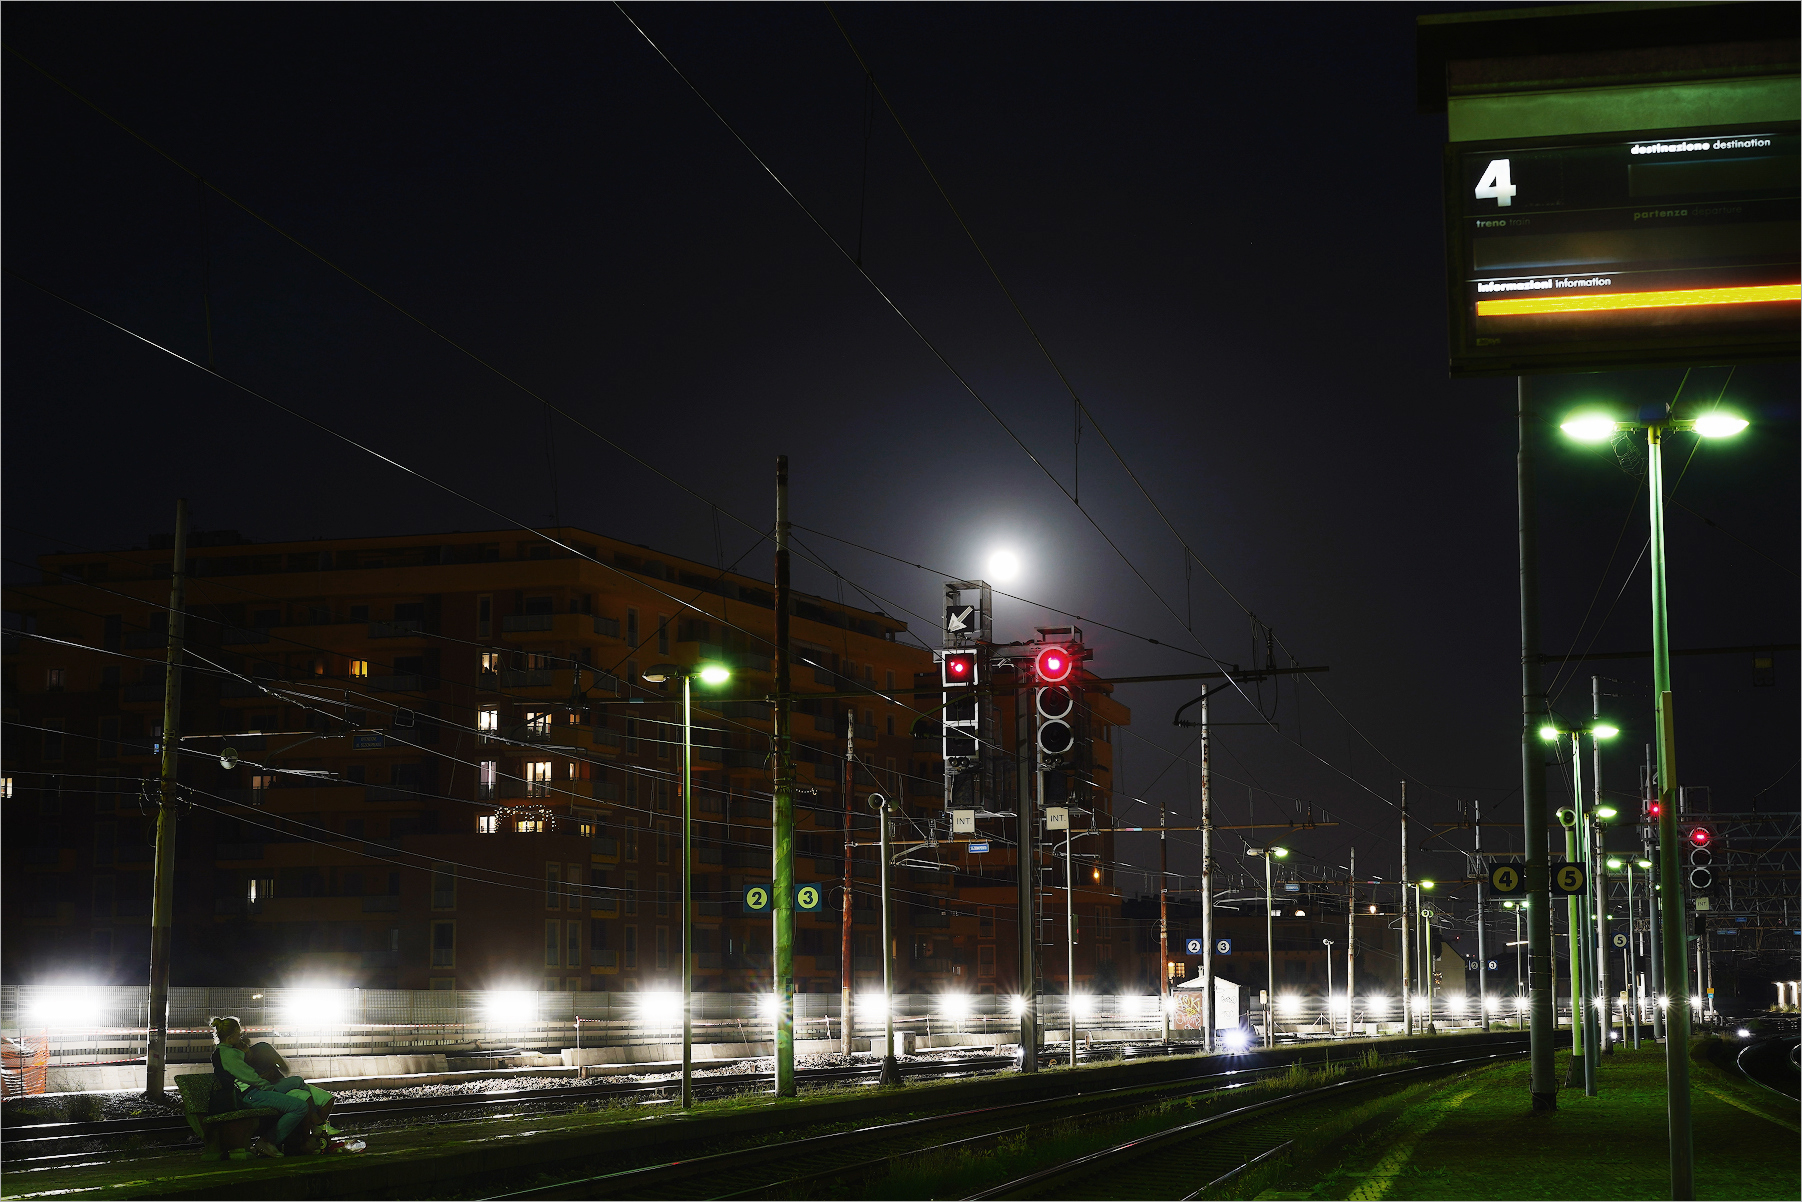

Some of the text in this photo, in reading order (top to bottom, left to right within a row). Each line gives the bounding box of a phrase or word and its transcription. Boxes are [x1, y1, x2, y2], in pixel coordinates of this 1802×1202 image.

[1631, 138, 1772, 155] destinazione destination
[1475, 159, 1517, 207] 4
[1634, 205, 1743, 221] partenza departure
[1476, 217, 1531, 228] treno train
[1477, 277, 1612, 293] informazioni information
[1498, 871, 1513, 887] 4
[1564, 870, 1577, 887] 5
[751, 891, 762, 906] 2
[802, 890, 814, 905] 3
[1191, 942, 1198, 951] 2
[1220, 942, 1227, 951] 3
[1616, 936, 1624, 945] 5
